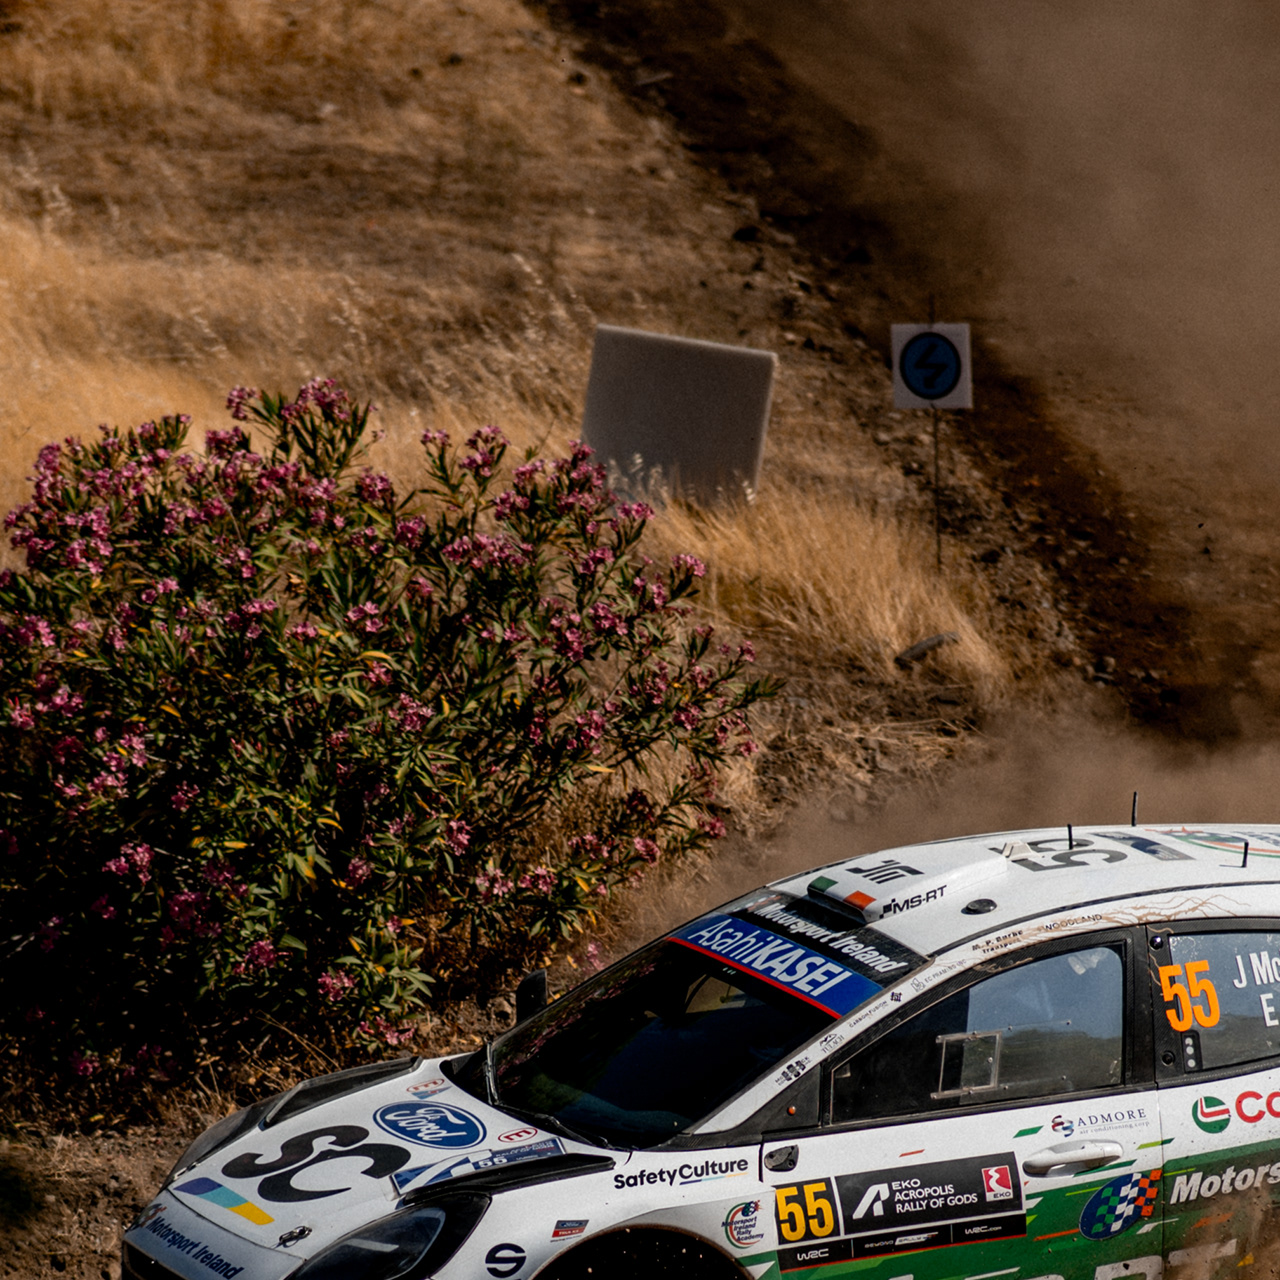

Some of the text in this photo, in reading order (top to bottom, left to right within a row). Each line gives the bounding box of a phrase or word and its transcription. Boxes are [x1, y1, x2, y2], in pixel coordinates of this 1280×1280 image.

[1045, 913, 1103, 931] WOODLAND
[754, 902, 908, 973] Motorsport Ireland
[687, 918, 853, 996] AsahiKASEI
[1233, 955, 1247, 989] J
[1158, 960, 1220, 1032] 55
[1260, 993, 1279, 1027] E
[385, 1107, 467, 1141] Ford
[1077, 1108, 1147, 1127] ADMORE
[478, 1156, 507, 1168] 55
[614, 1159, 749, 1189] SafetyCulture
[892, 1179, 921, 1190] EKO
[894, 1184, 955, 1202] ACROPOLIS
[895, 1193, 978, 1214] RALLY OF GODS
[993, 1191, 1012, 1199] EKO
[721, 1216, 757, 1227] Motorsport
[775, 1182, 834, 1242] 55
[734, 1223, 756, 1231] Ireland
[146, 1216, 244, 1280] Motorsport Ireland
[797, 1249, 829, 1261] WRC
